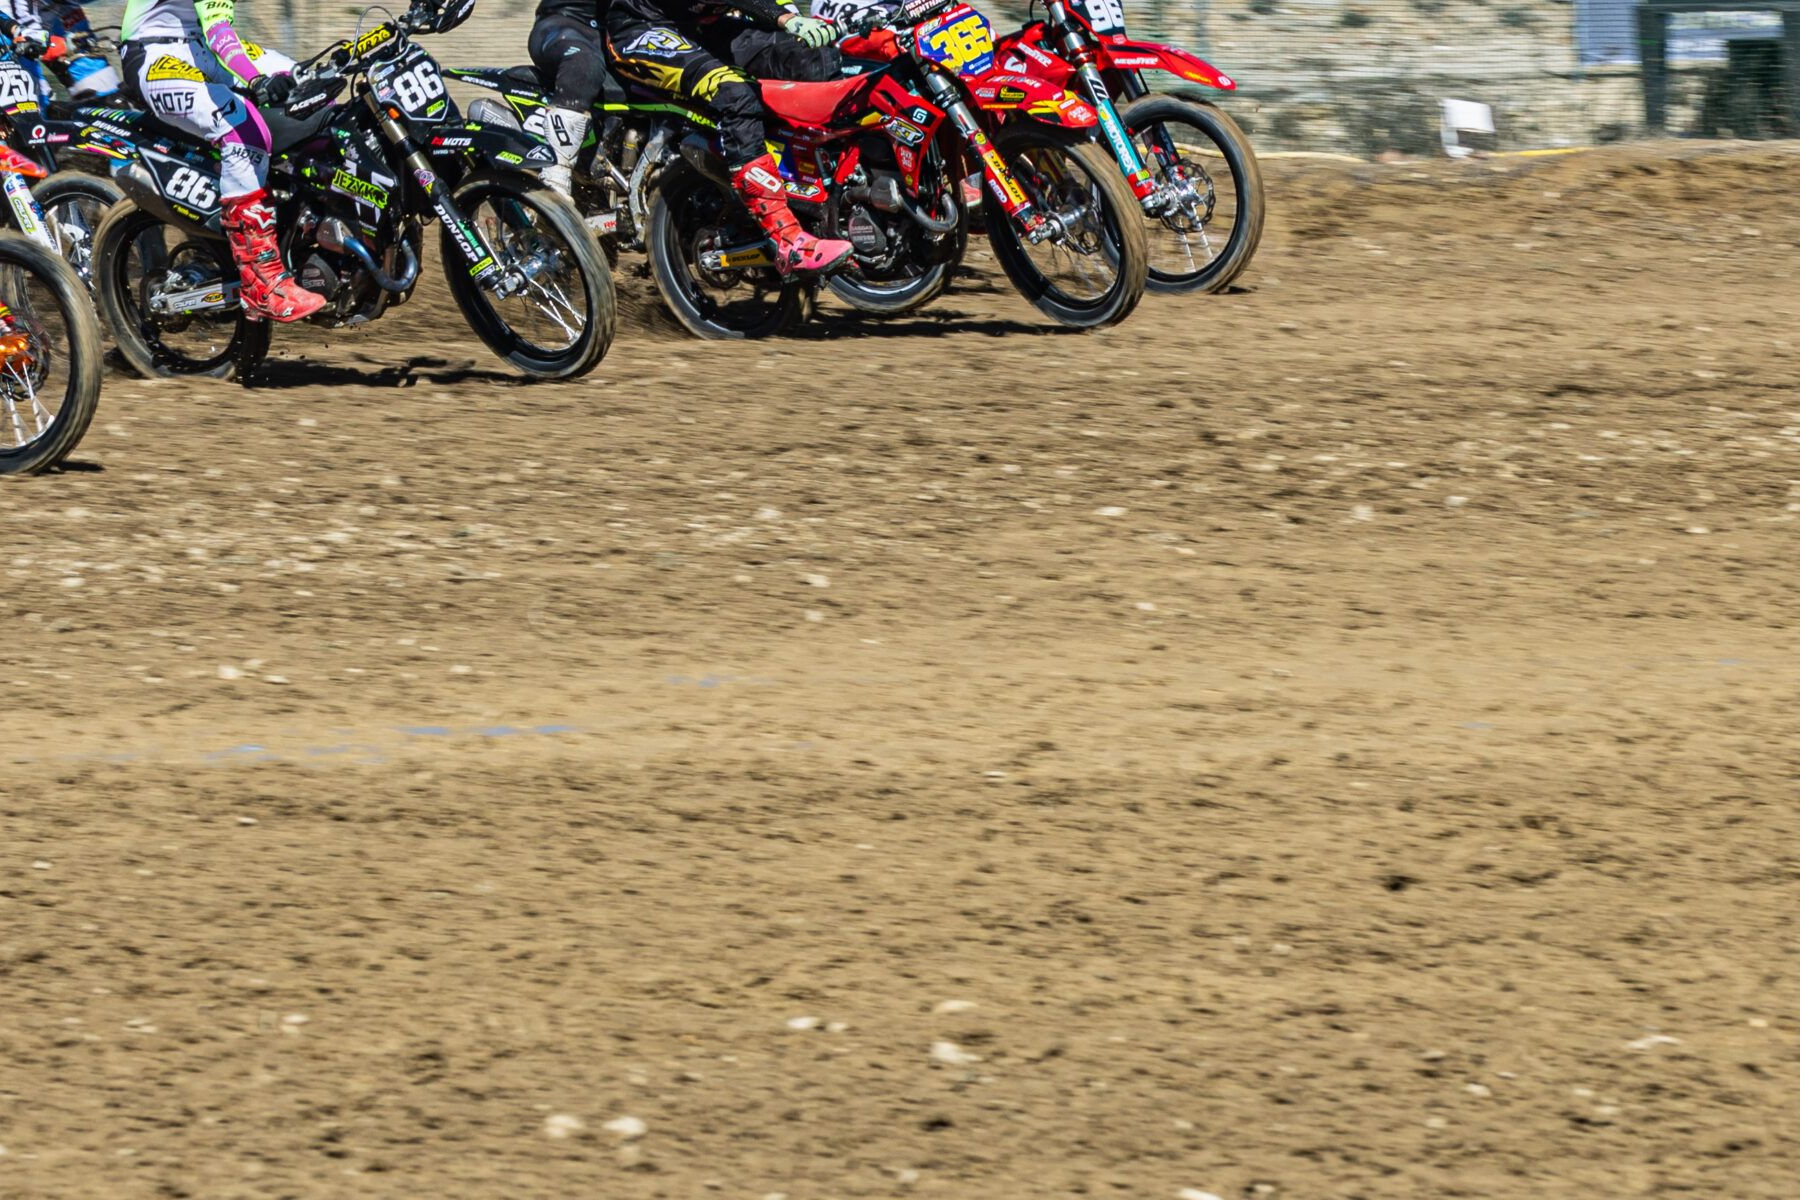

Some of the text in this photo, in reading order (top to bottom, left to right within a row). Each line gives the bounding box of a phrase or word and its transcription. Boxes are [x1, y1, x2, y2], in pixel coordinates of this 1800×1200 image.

[929, 13, 994, 70] 365
[149, 91, 196, 114] MOTS
[393, 59, 445, 114] 86
[1104, 117, 1137, 171] MOTOREX
[164, 165, 218, 210] 86
[433, 203, 480, 263] DUNLOP
